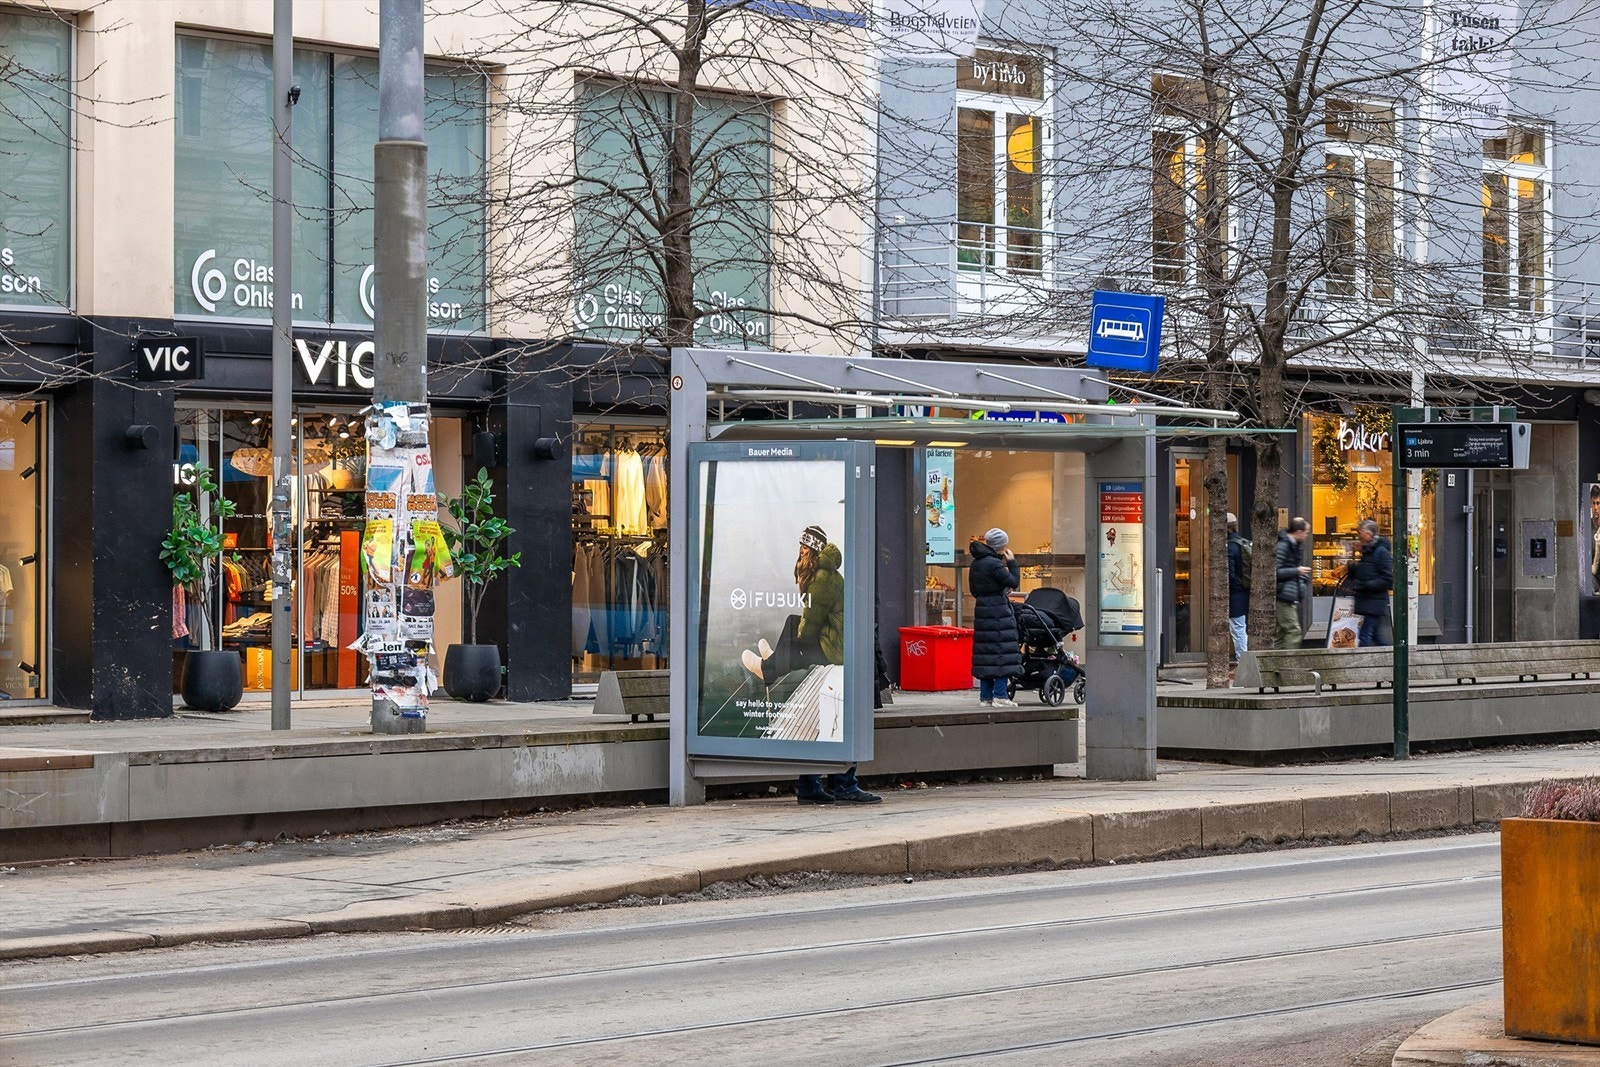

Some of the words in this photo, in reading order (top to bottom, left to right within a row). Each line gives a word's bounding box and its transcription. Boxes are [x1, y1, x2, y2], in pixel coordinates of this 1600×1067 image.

[1450, 11, 1499, 29] Tusen
[973, 59, 1026, 85] byTiMo
[1, 274, 41, 293] son
[233, 284, 303, 310] Ohlsn
[604, 283, 642, 305] Clas
[426, 295, 463, 320] lson
[604, 306, 663, 329] Ohlson
[142, 345, 190, 371] VIC
[295, 338, 375, 390] VIC
[748, 447, 769, 456] Bauer
[770, 447, 793, 456] Media
[1407, 448, 1413, 458] 3
[1414, 448, 1430, 458] min
[172, 463, 197, 485] IC
[340, 585, 357, 596] 50%
[755, 592, 812, 609] FUBUKI
[379, 642, 402, 651] ten
[735, 700, 748, 709] say
[748, 699, 765, 708] hello
[765, 700, 773, 708] to
[743, 709, 765, 718] winter
